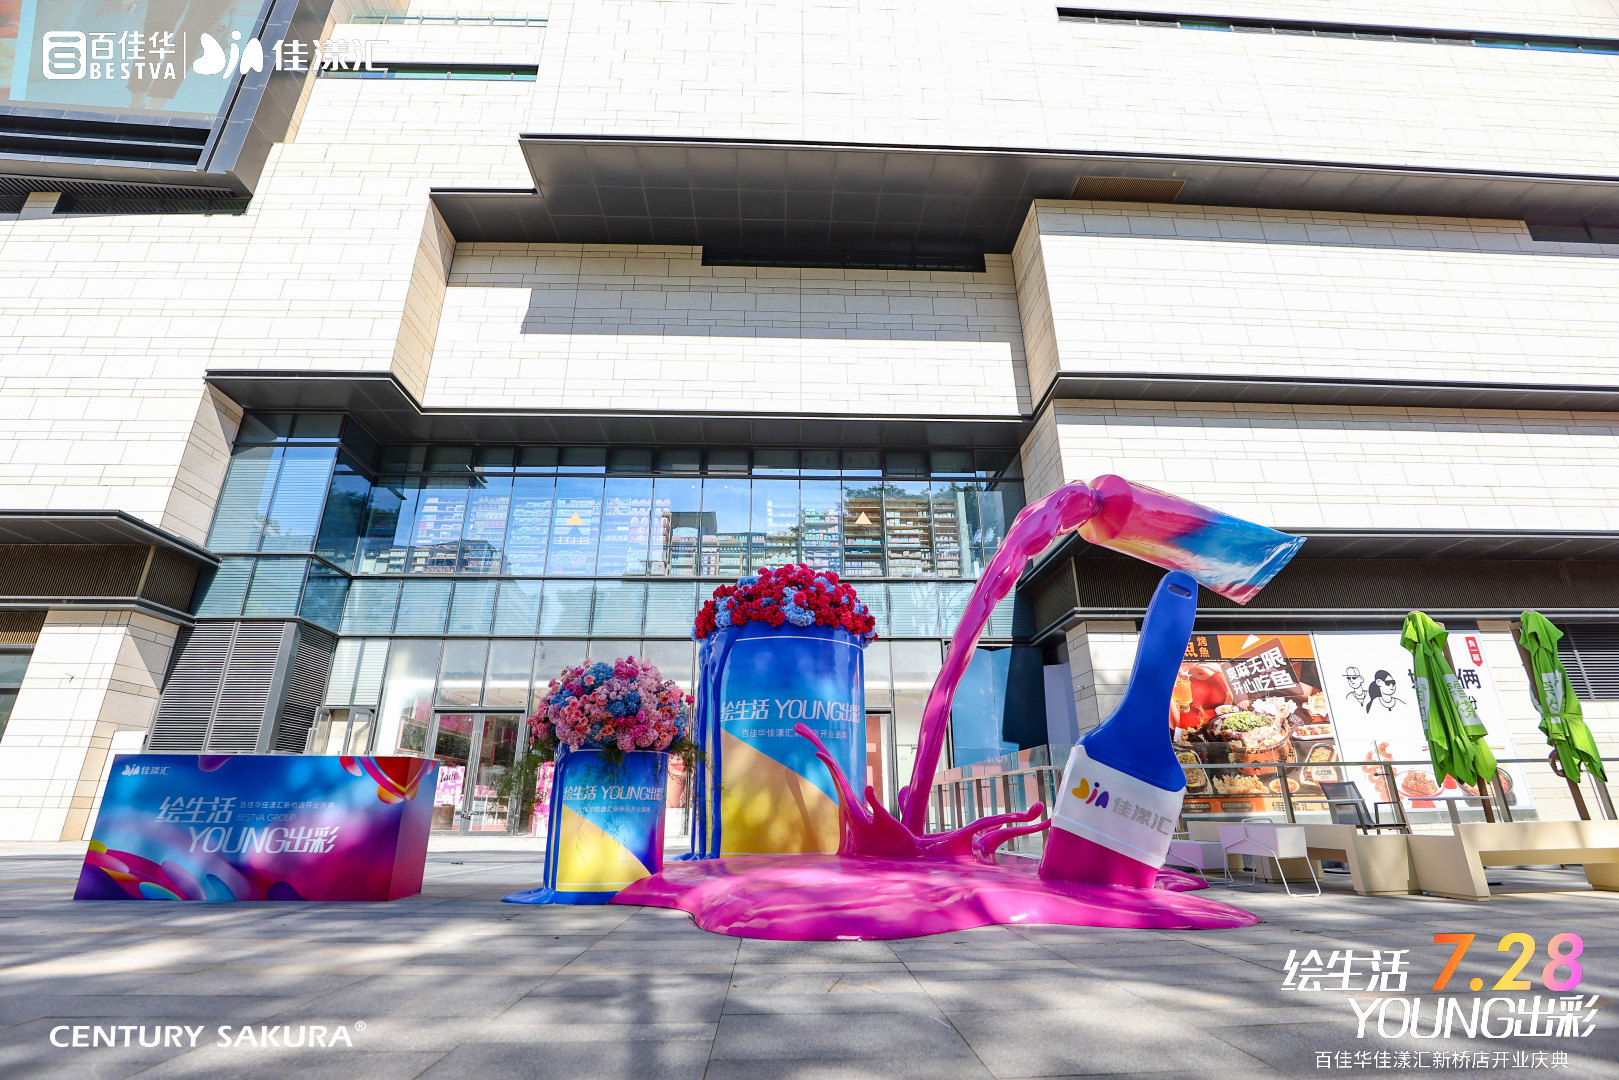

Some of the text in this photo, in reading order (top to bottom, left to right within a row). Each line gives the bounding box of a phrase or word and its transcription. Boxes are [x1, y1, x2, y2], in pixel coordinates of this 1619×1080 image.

[1231, 669, 1297, 695] 开心吃鱼
[720, 698, 770, 722] 绘生活
[154, 796, 237, 823] 绘生活
[236, 813, 297, 822] BESTVA GROUP
[188, 826, 340, 853] YOUNG出彩
